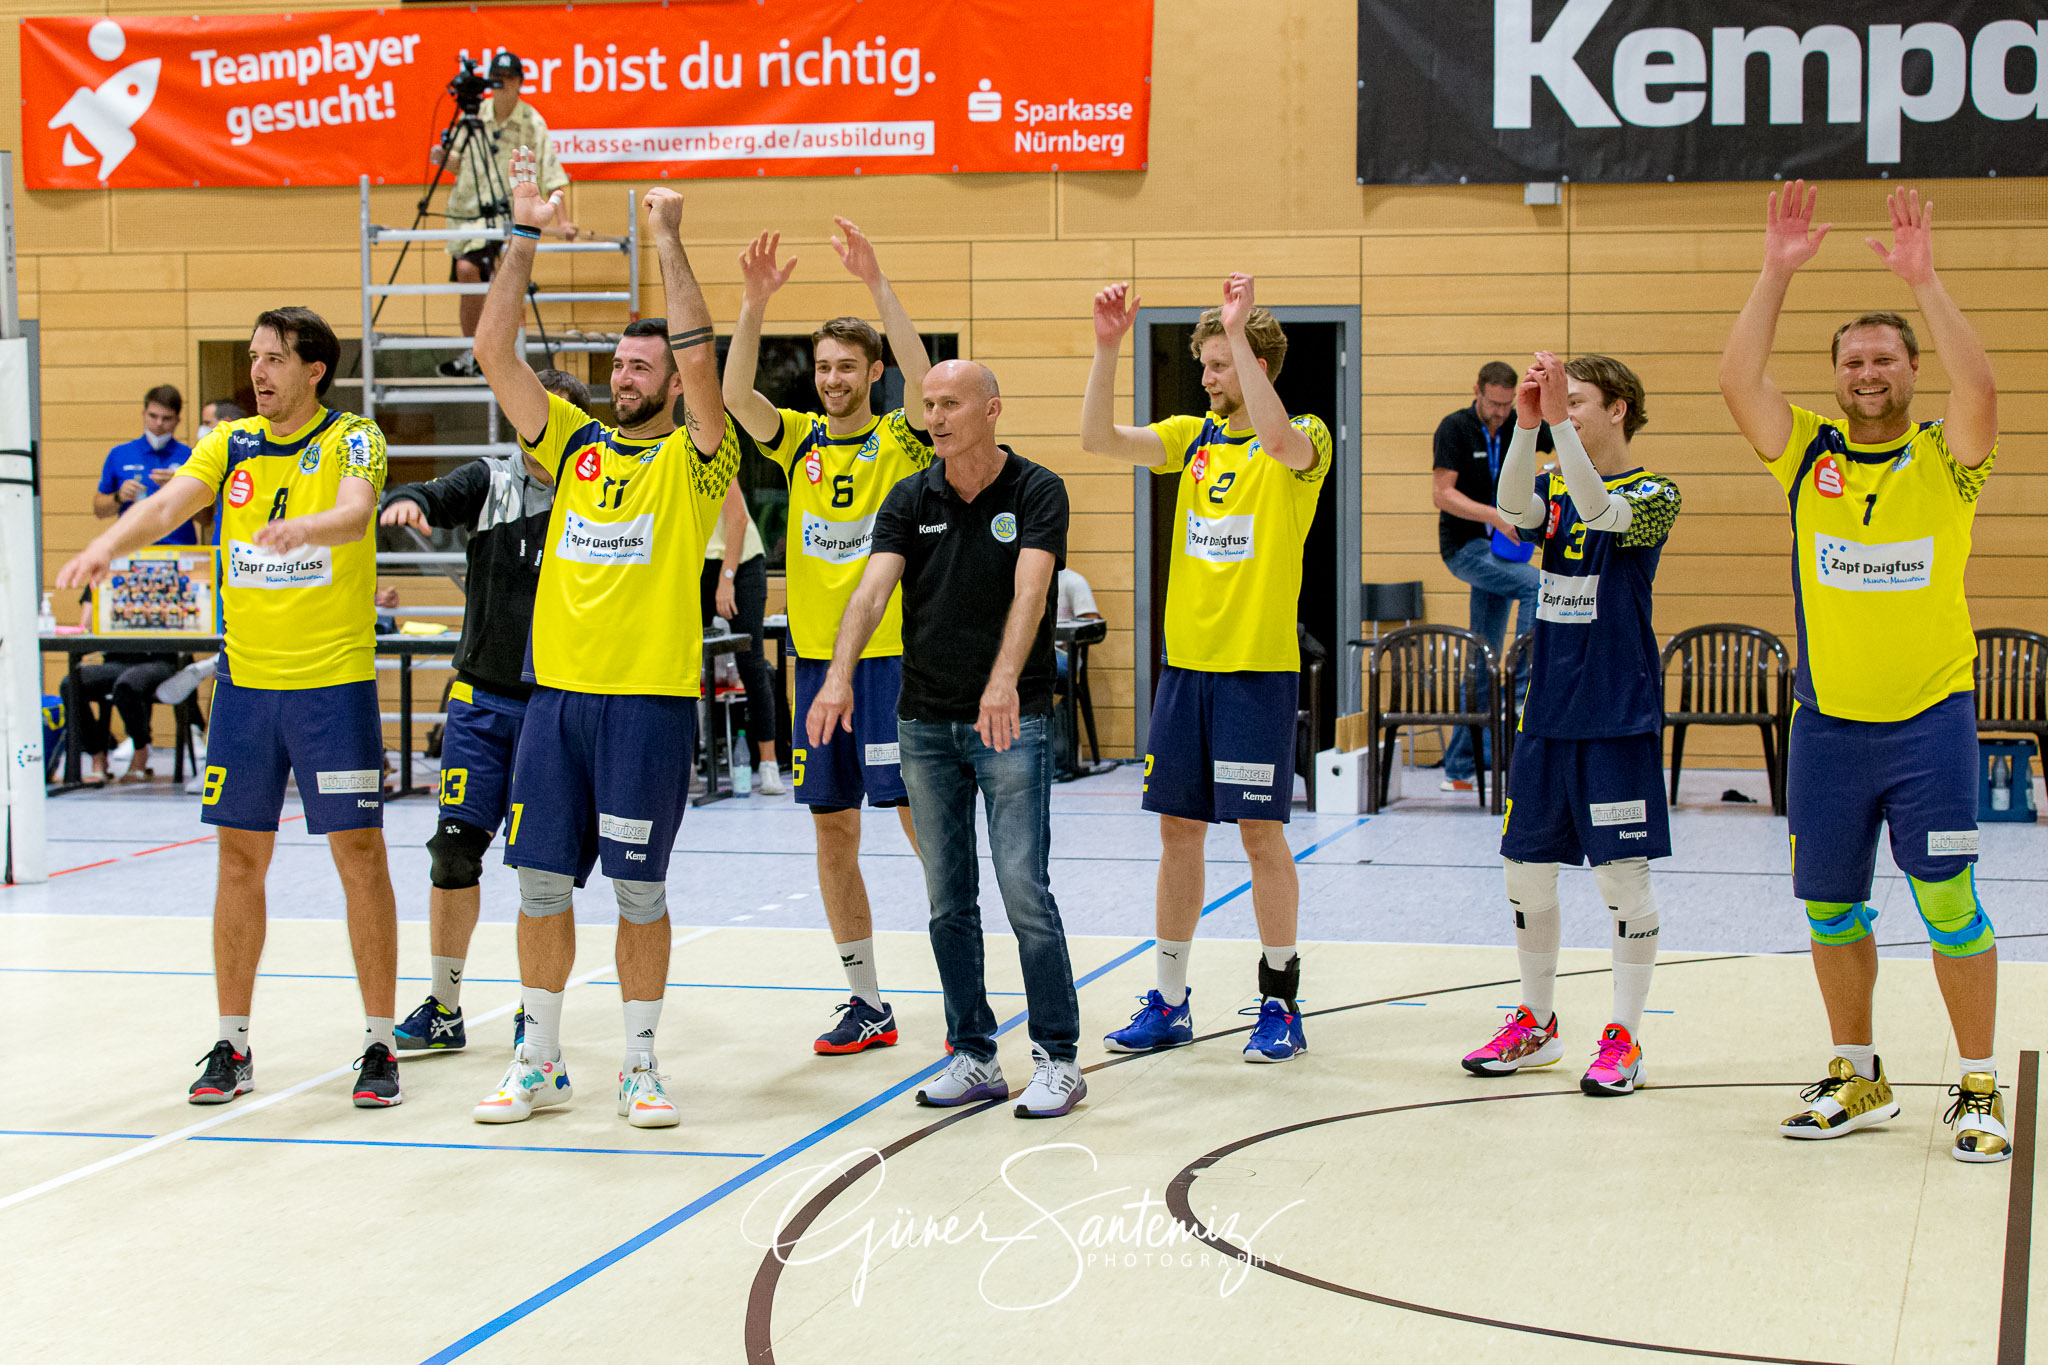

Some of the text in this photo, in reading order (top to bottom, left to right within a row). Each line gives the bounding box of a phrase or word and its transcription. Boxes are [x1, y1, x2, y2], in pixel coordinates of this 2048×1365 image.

[190, 33, 421, 88] Teamplayer
[574, 43, 668, 92] bist
[679, 40, 742, 90] du
[759, 35, 936, 96] richtig.
[1492, 0, 2048, 163] Kempa
[226, 80, 397, 146] gesucht!
[1014, 98, 1133, 127] Sparkasse
[552, 127, 926, 155] arkasse-nuernberg.de/ausbildung
[1014, 129, 1125, 157] Nürnberg
[832, 474, 854, 508] 6
[1209, 472, 1236, 504] 2
[1563, 522, 1587, 560] 3
[238, 560, 323, 574] Zapf Daigfuss
[1831, 558, 1925, 575] Zapf Daigfuss
[793, 749, 808, 786] 6
[202, 765, 227, 805] 8
[1243, 791, 1272, 804] Kempa
[1619, 830, 1648, 841] Kempa
